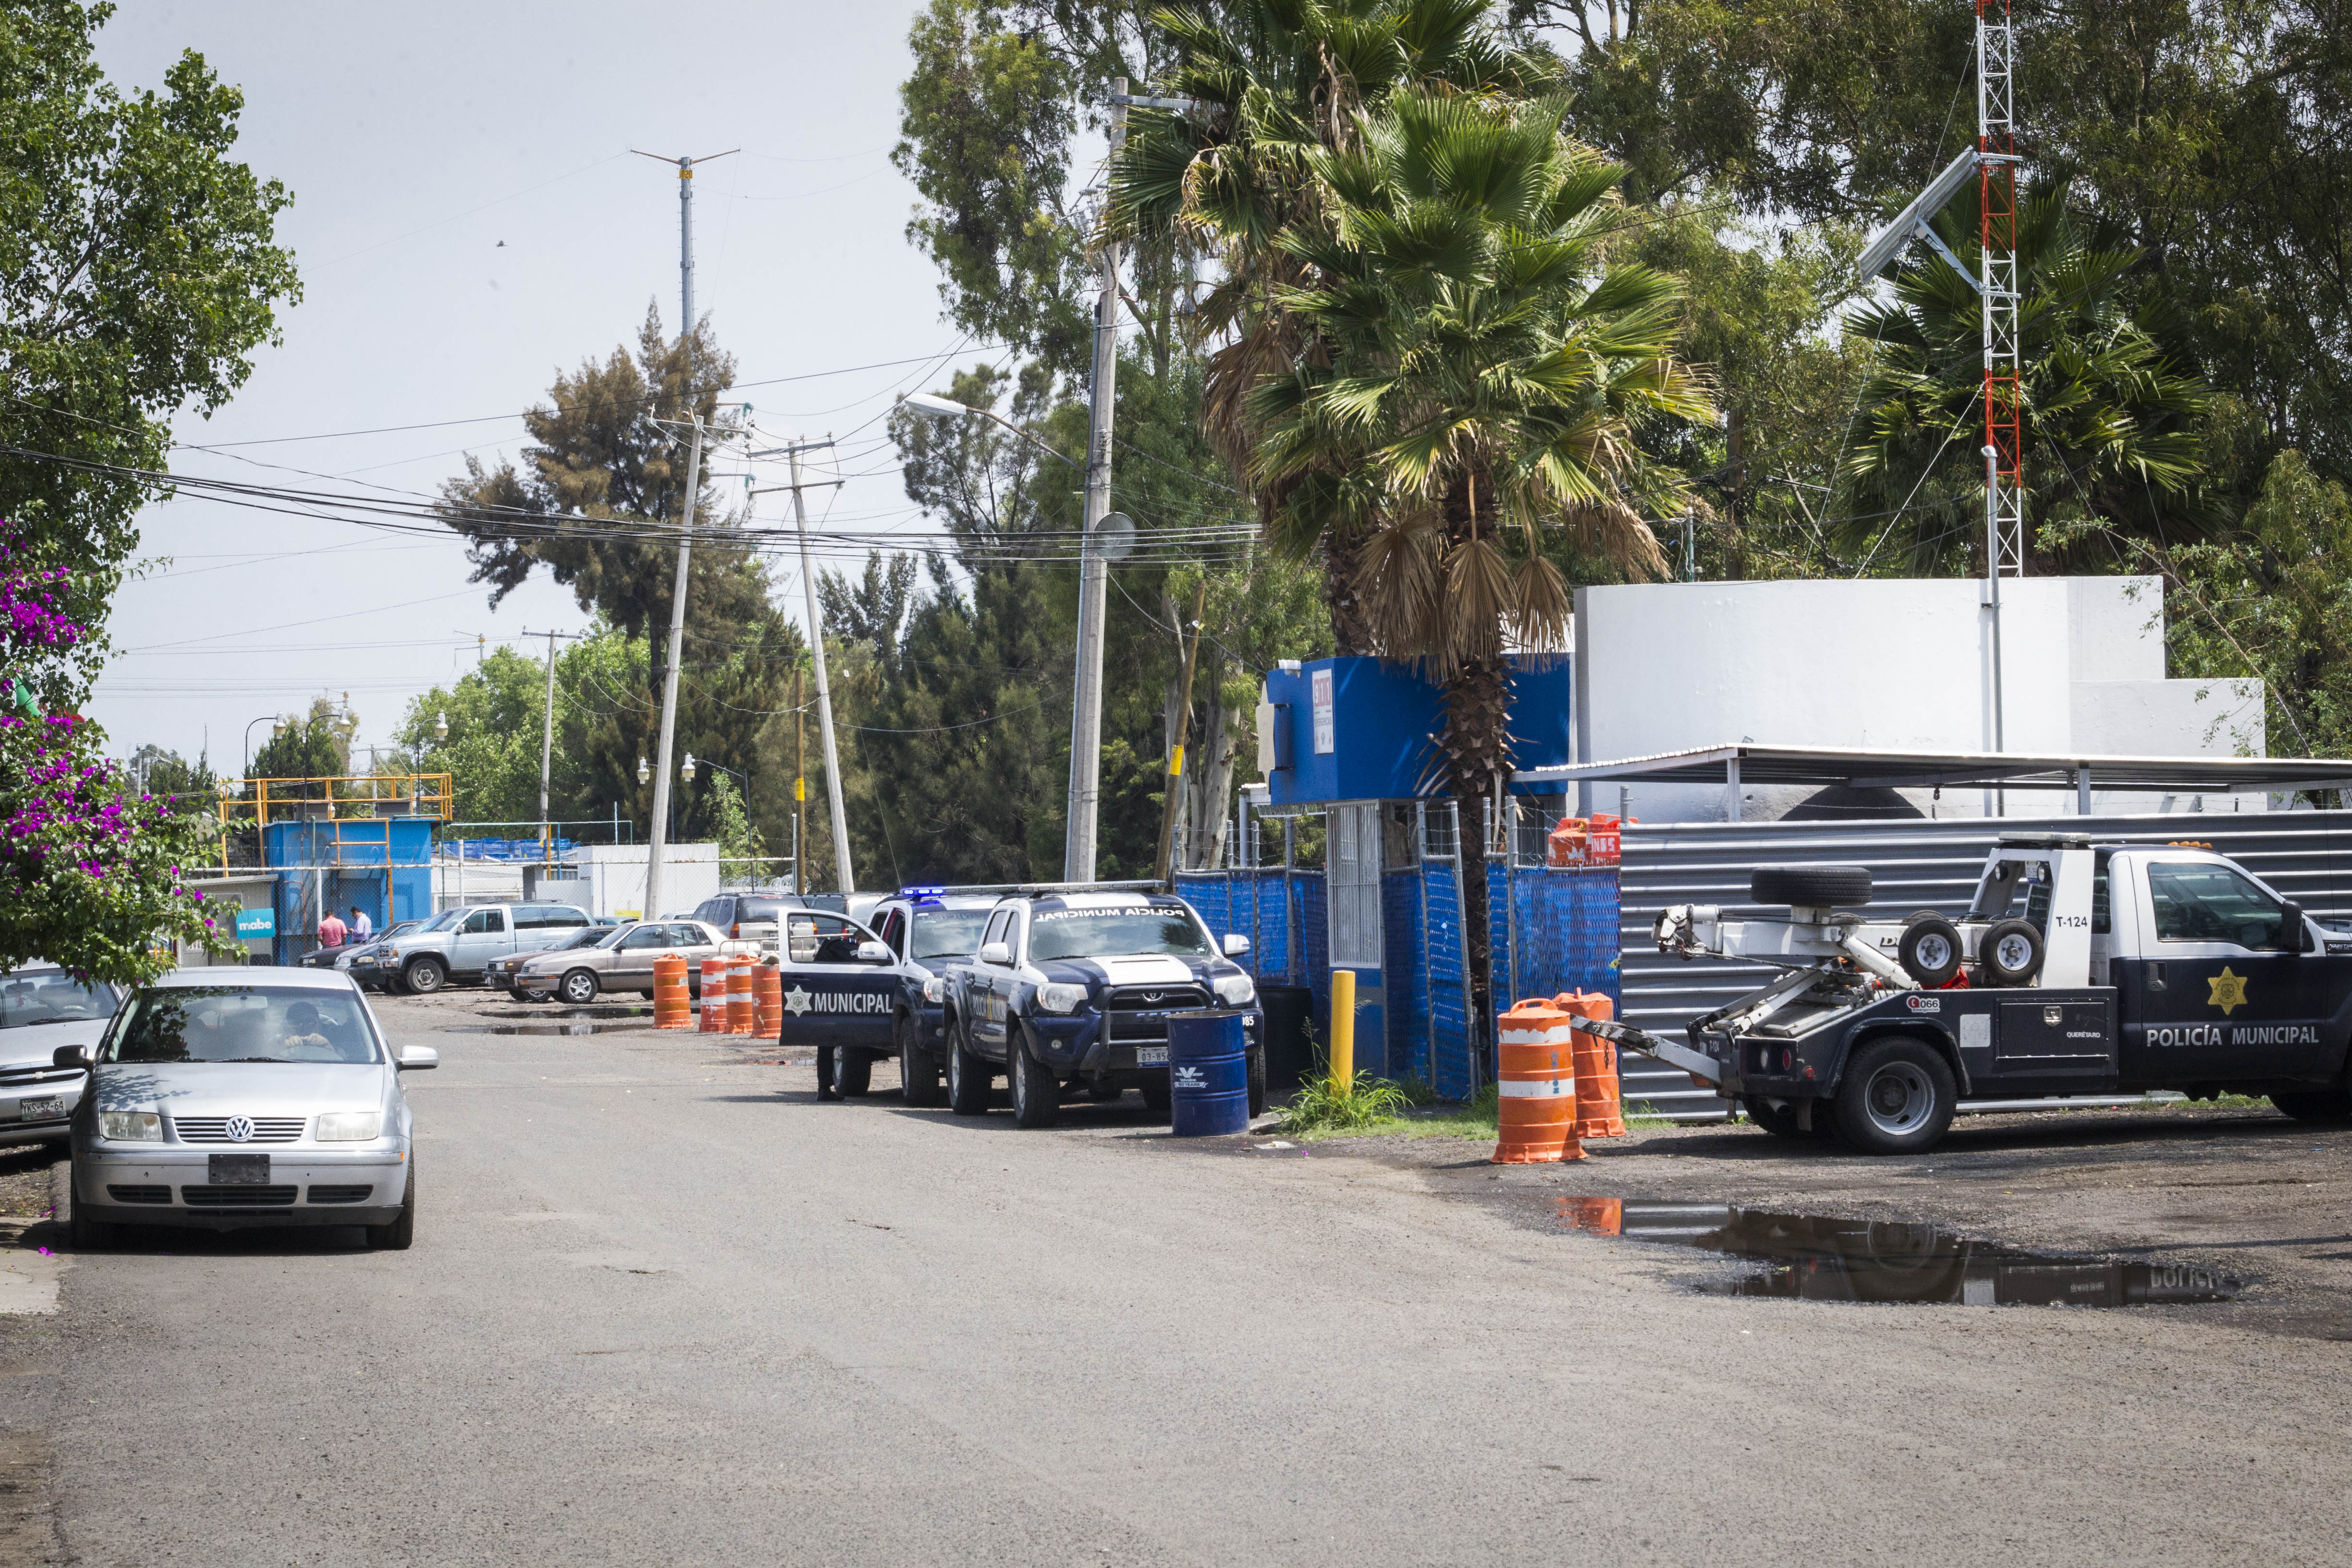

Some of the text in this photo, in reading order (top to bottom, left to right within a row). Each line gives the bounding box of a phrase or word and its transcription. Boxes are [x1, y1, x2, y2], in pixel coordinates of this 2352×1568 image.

[1315, 681, 1330, 704] 911
[238, 918, 272, 930] mabe
[2056, 916, 2088, 927] T-124
[814, 993, 893, 1013] MUNICIPAL
[1920, 1000, 1938, 1008] 066
[2147, 1024, 2319, 1047] POLICÍA MUNICIPAL
